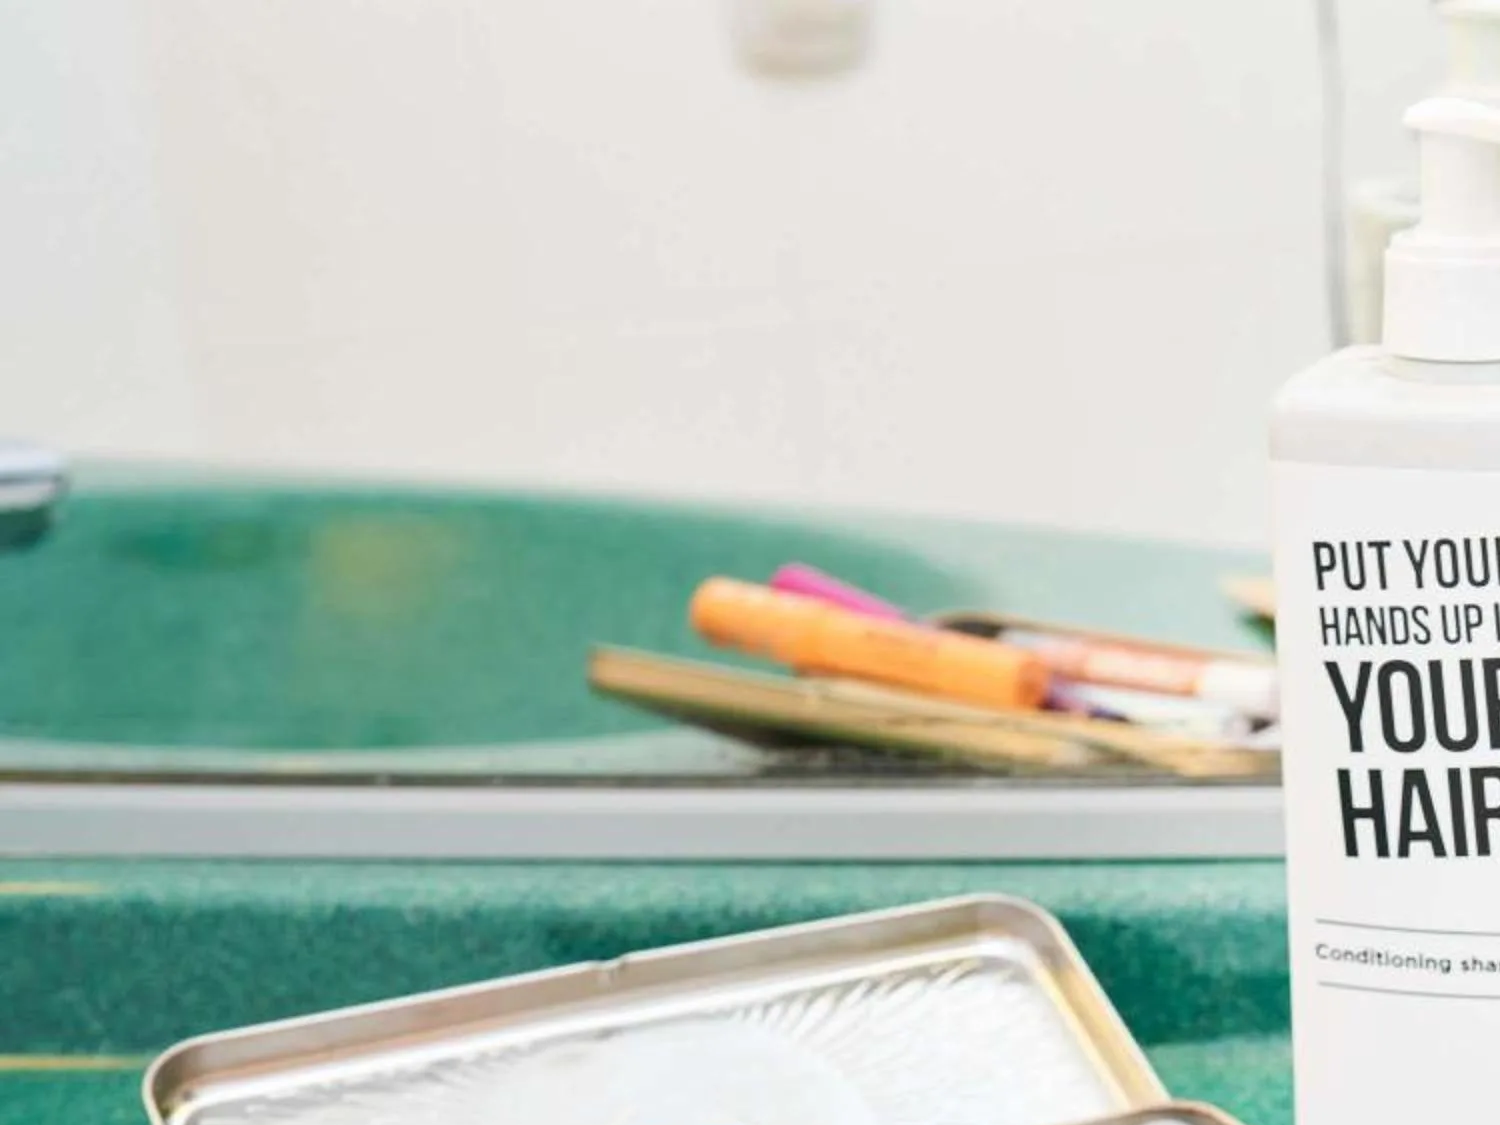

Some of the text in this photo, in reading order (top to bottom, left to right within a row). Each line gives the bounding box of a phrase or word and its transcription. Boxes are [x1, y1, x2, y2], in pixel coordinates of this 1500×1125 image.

[1313, 541, 1391, 590] PUT
[1319, 605, 1431, 645] HANDS
[1441, 604, 1483, 644] UP
[1315, 943, 1451, 974] Conditioning
